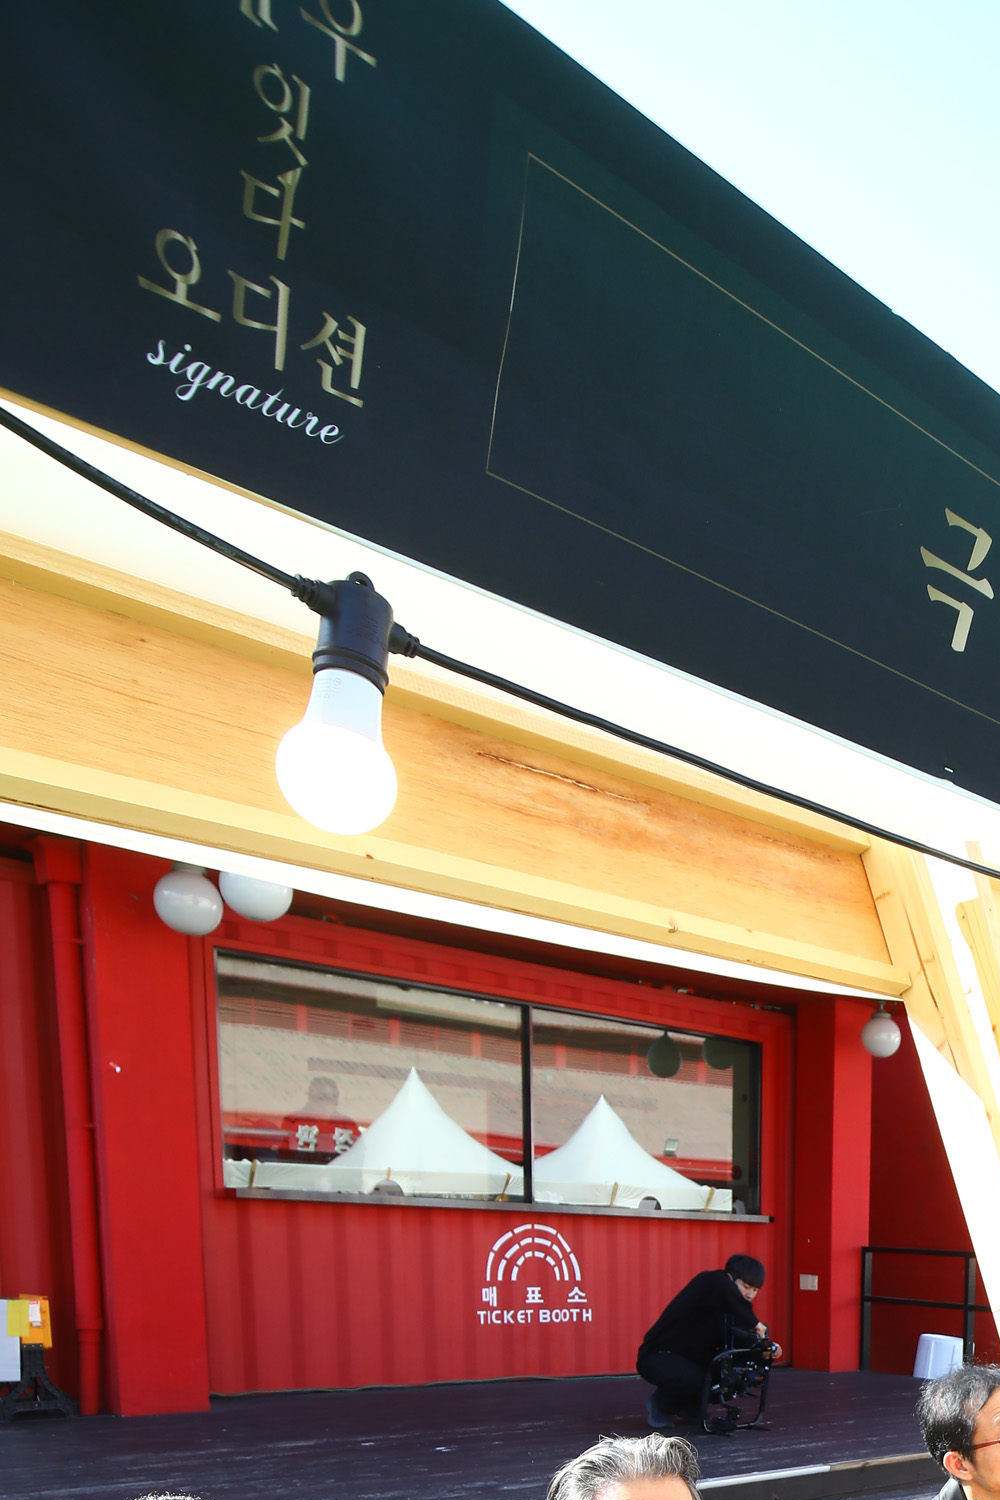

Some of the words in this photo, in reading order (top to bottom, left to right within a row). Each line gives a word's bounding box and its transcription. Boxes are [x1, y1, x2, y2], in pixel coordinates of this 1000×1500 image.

[137, 227, 366, 408] 오디션
[146, 338, 345, 445] signature
[477, 1309, 534, 1325] TICKET
[539, 1308, 592, 1323] BOOTH
